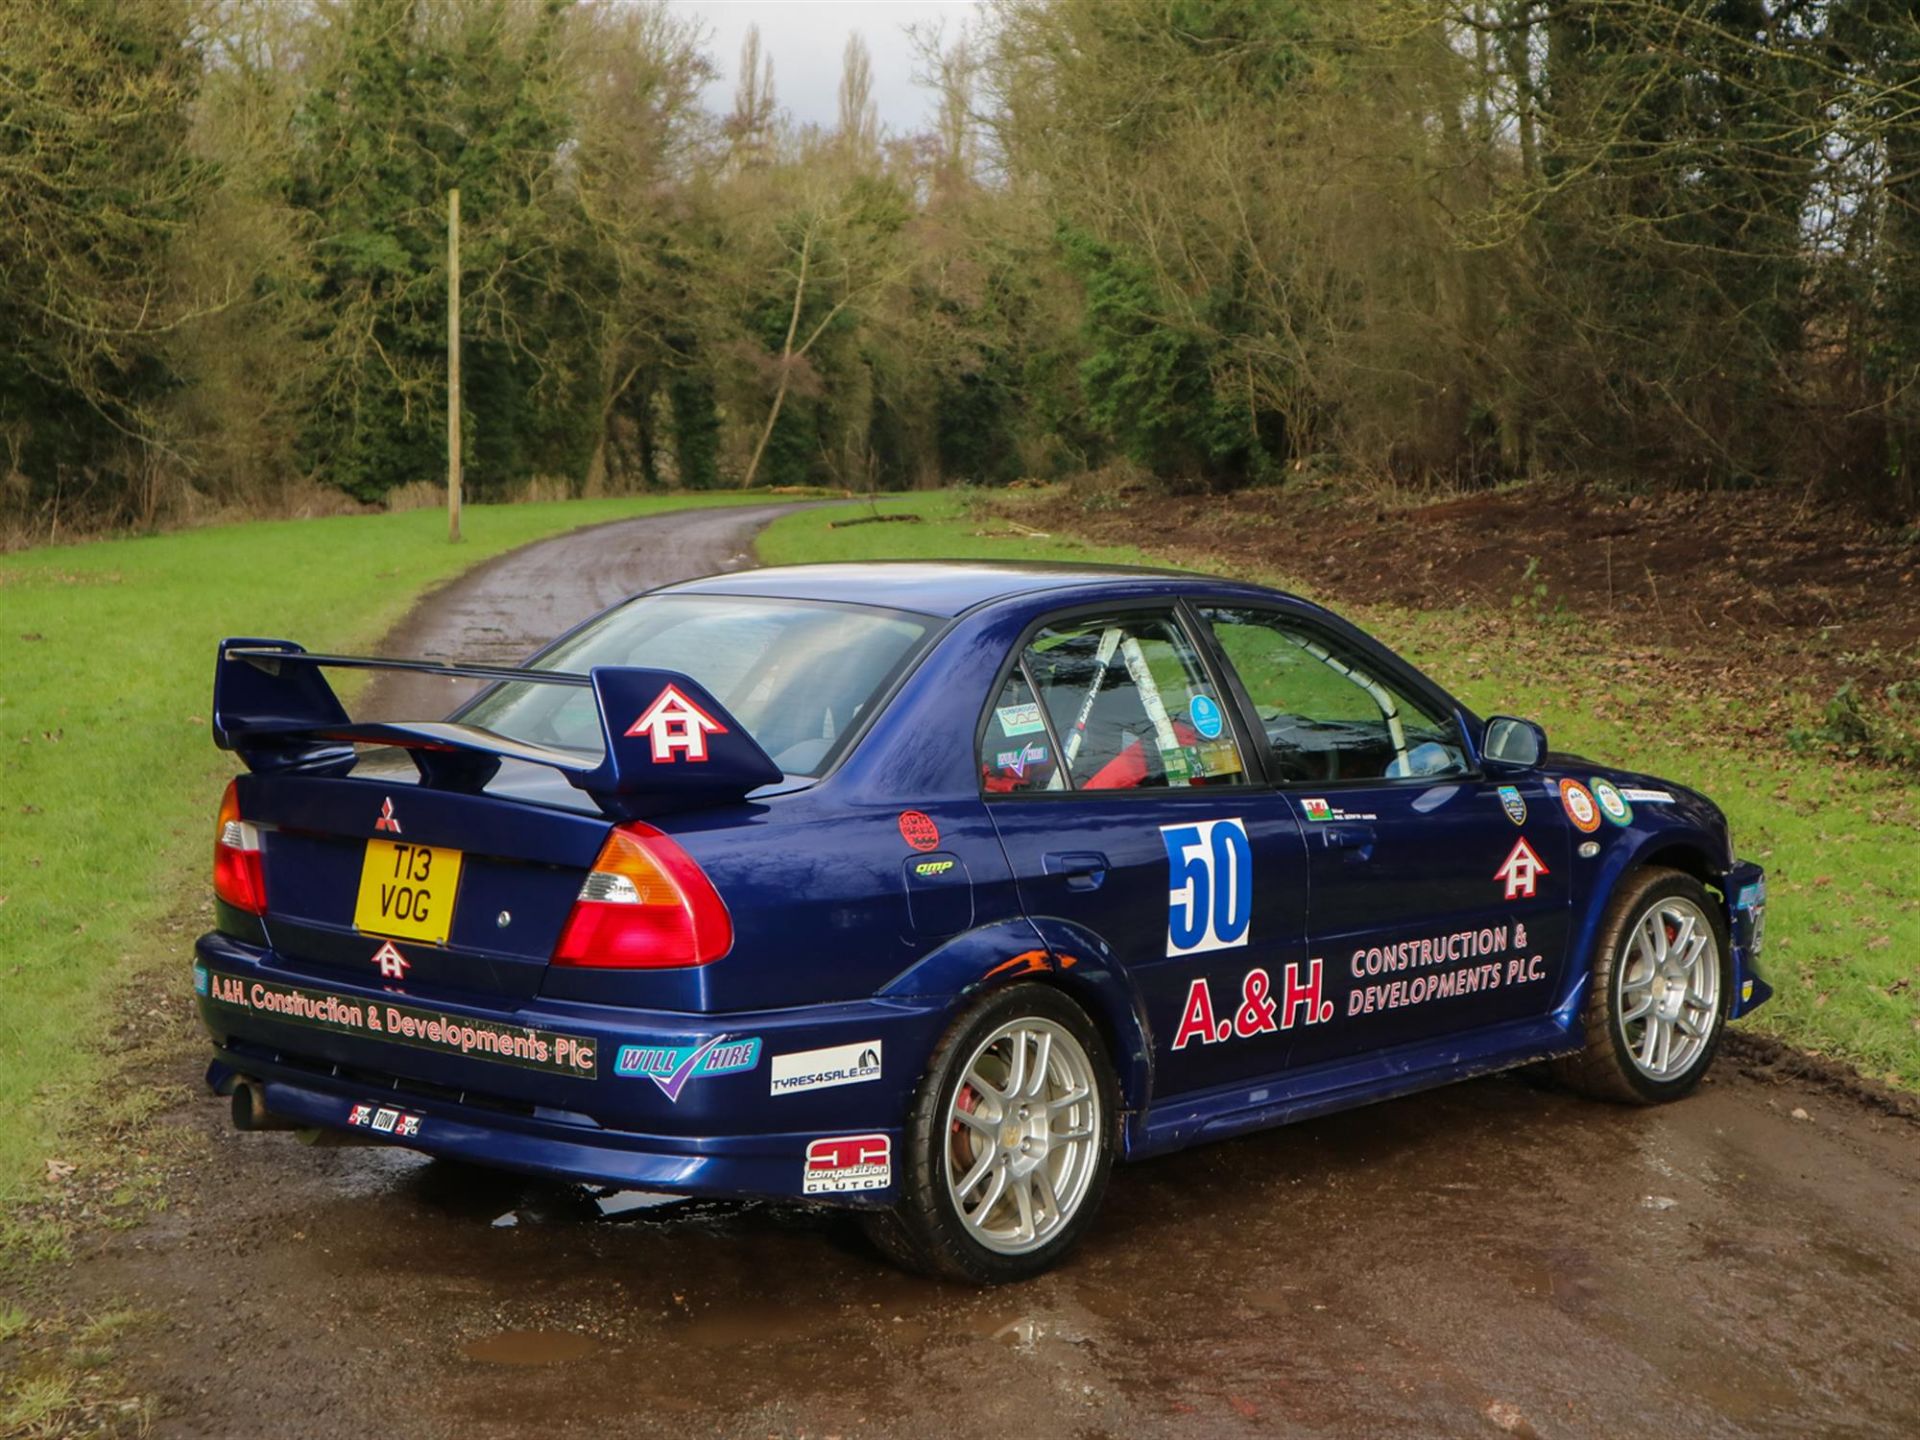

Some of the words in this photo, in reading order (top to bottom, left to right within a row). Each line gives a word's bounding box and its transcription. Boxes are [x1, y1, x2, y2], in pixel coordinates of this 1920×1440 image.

[394, 844, 432, 882] T13
[1161, 821, 1253, 950] 50
[382, 883, 431, 922] VOG
[1351, 925, 1508, 978] CONSTRUCTION
[1514, 922, 1528, 949] &
[1171, 958, 1334, 1050] A.&H.
[1348, 963, 1502, 1016] DEVELOPMENTS
[1506, 955, 1546, 985] PLC.
[250, 983, 362, 1028] Construction
[367, 1005, 382, 1031] &
[386, 1007, 548, 1062] Developments
[555, 1038, 594, 1070] Plc
[620, 1049, 677, 1072] WILL
[703, 1042, 754, 1071] HIRE
[374, 1111, 396, 1130] TOW
[807, 1178, 888, 1193] CLUTCH
